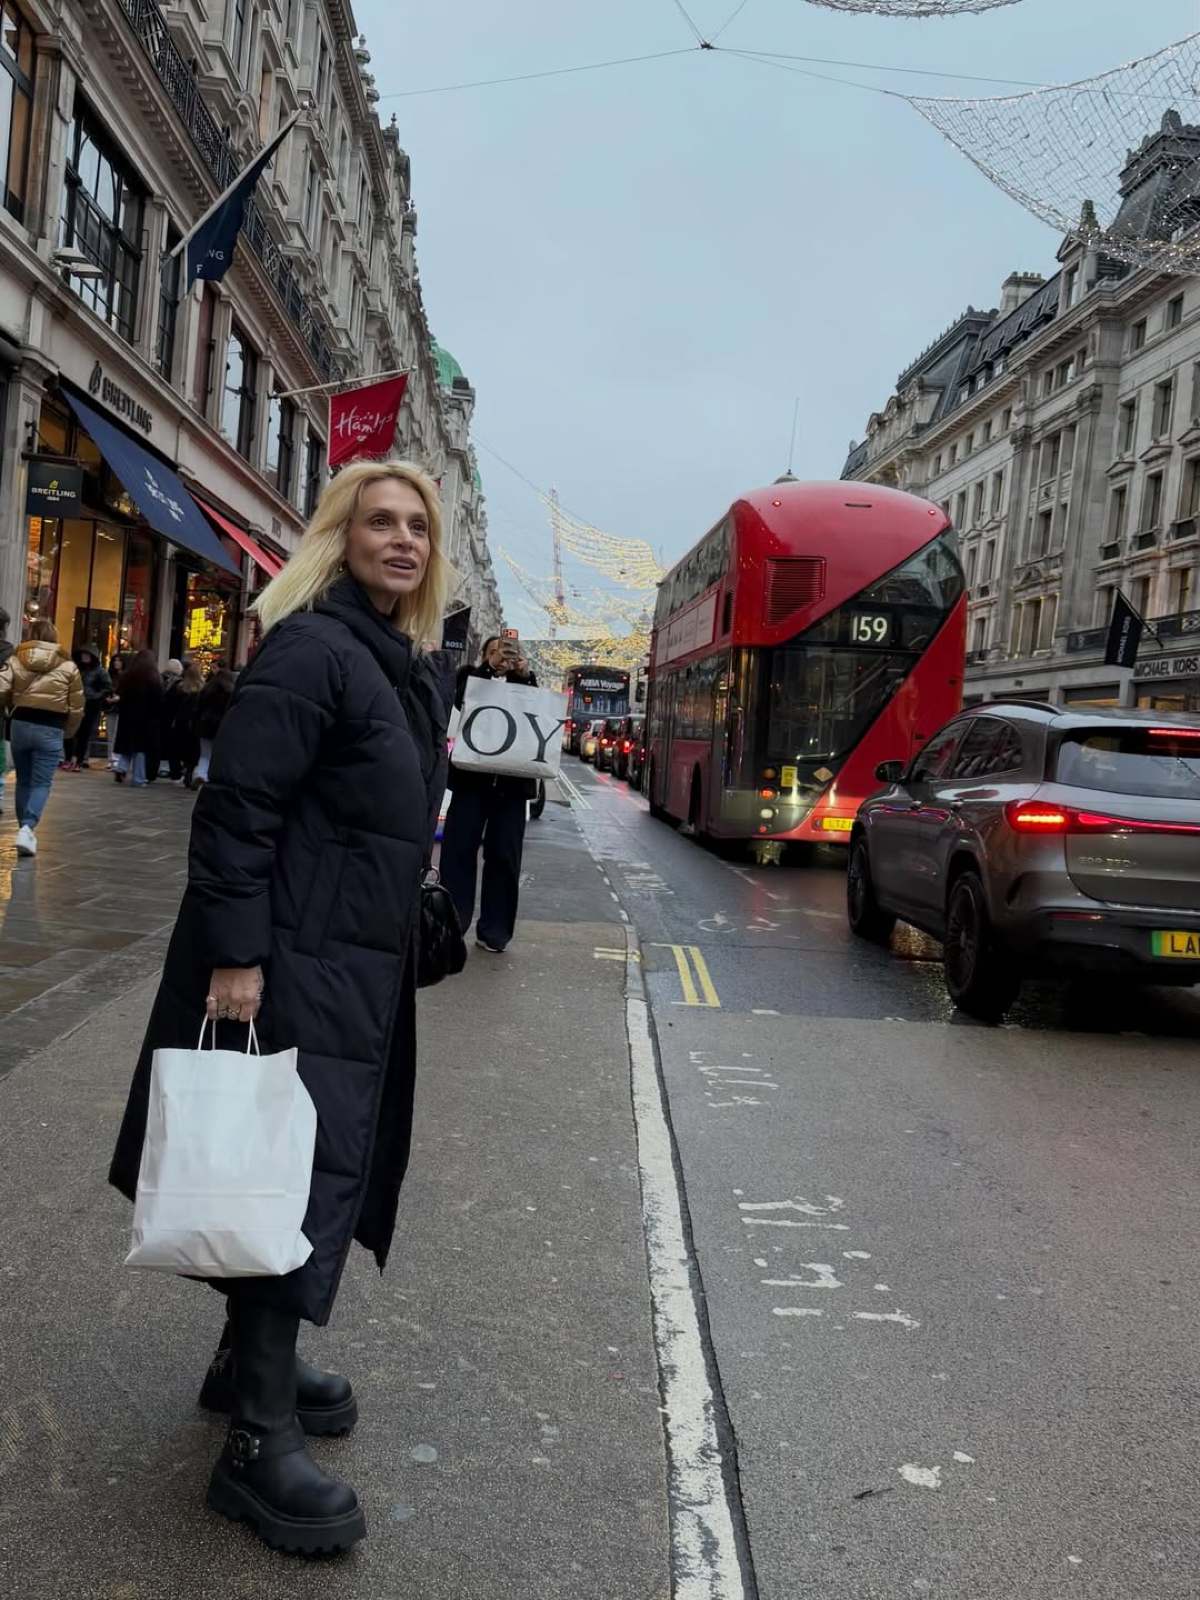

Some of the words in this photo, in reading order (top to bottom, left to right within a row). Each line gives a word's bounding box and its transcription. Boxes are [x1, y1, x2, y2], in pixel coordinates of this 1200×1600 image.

[102, 376, 153, 434] BREITLING
[31, 487, 76, 498] BREITLING
[852, 616, 888, 642] 159
[1133, 661, 1169, 677] MICHAEL
[1173, 657, 1198, 673] KORS
[1170, 935, 1200, 954] LA
